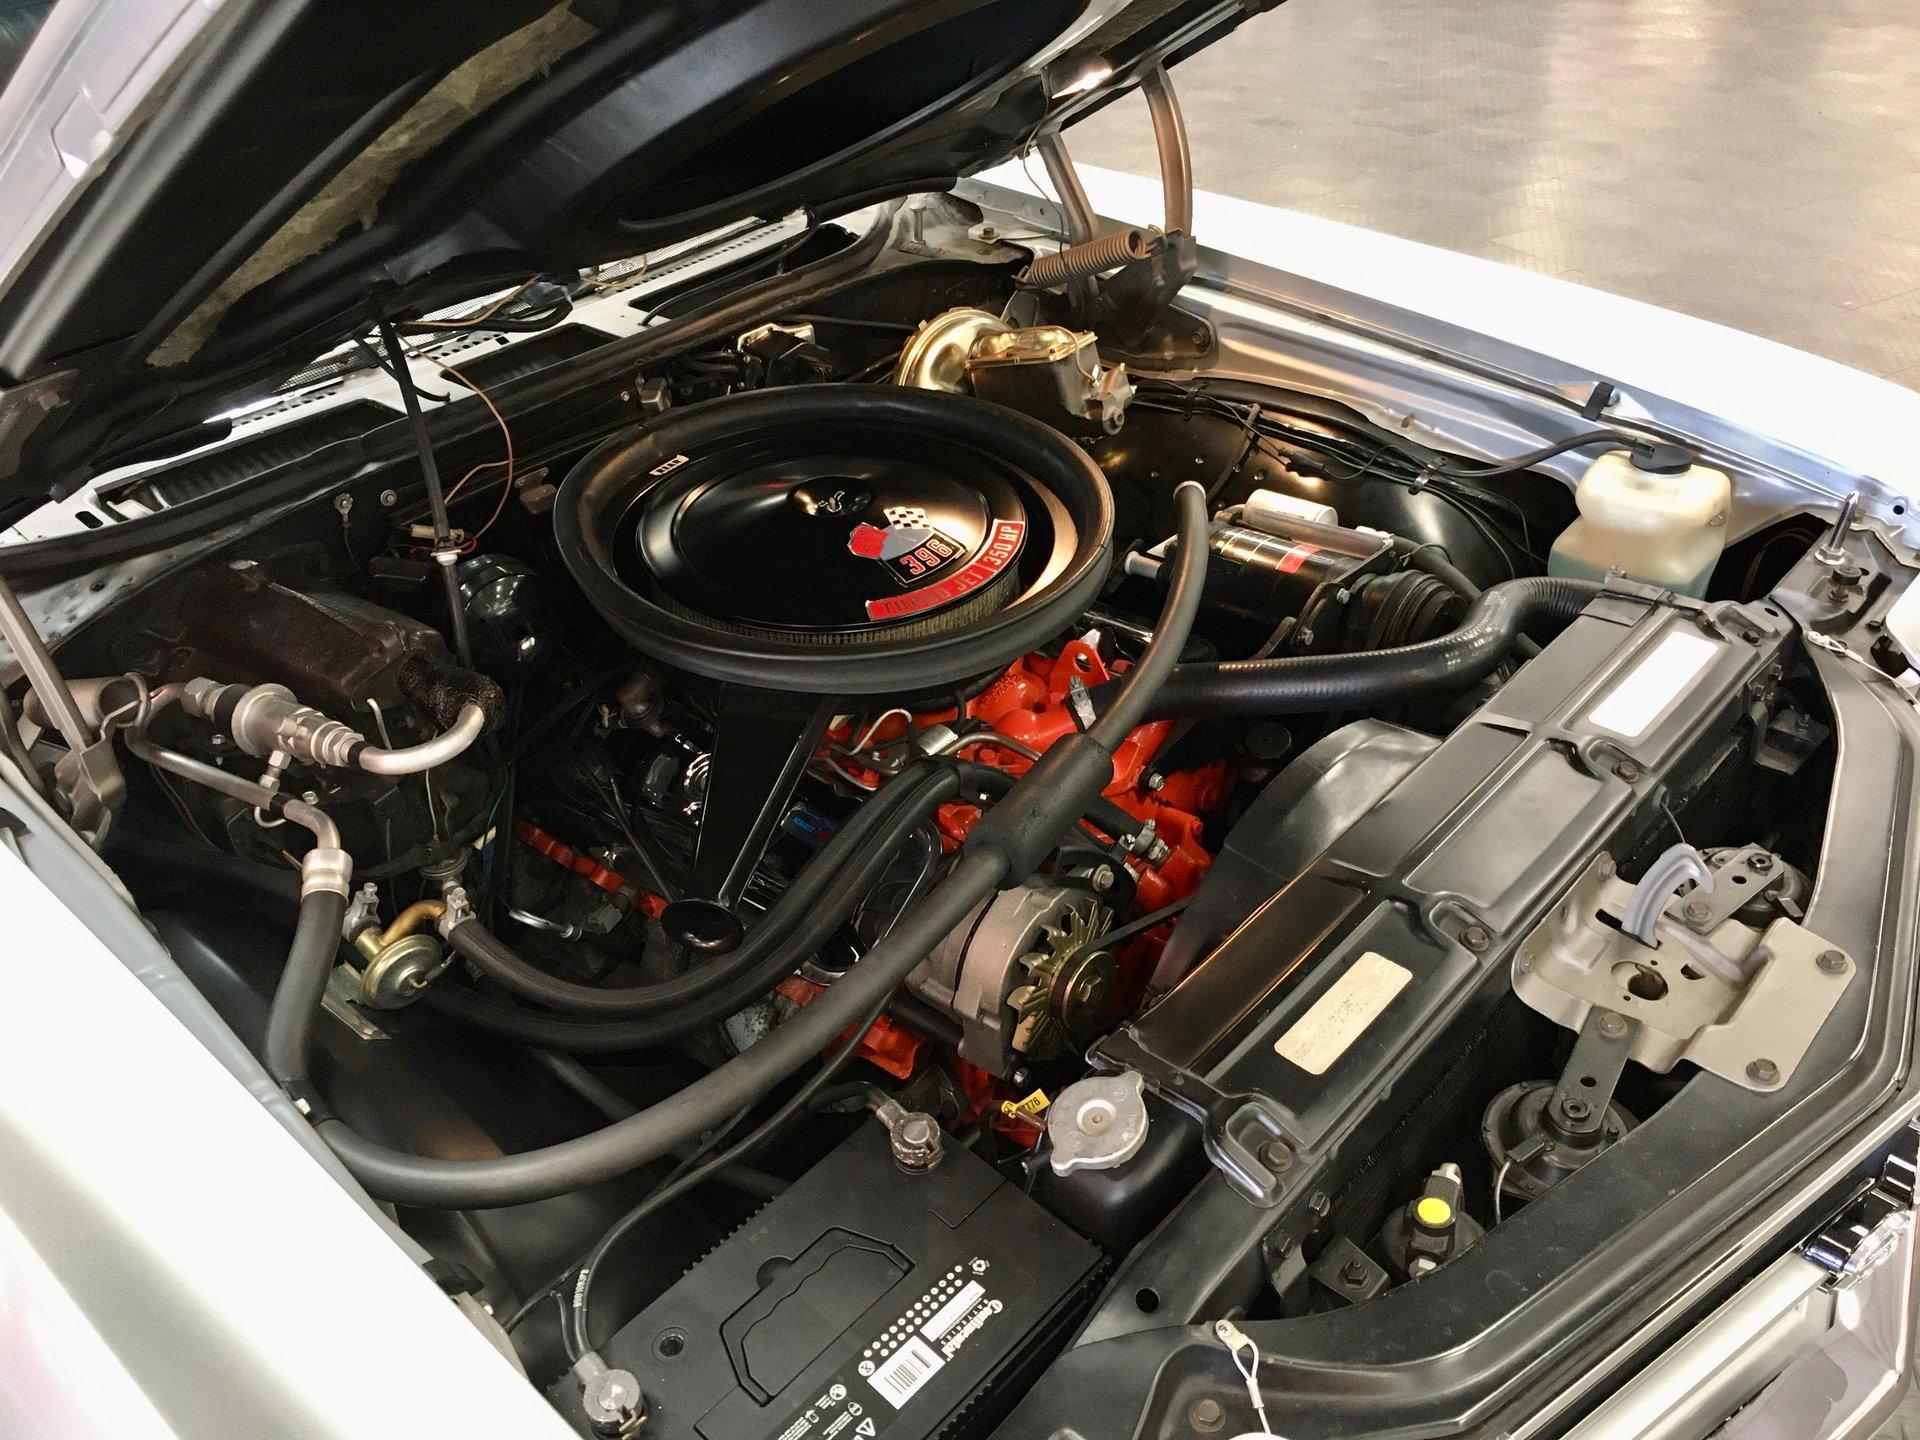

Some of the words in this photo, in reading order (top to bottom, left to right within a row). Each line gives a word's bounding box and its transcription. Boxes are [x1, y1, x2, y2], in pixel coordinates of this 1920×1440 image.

[899, 538, 954, 576] 396
[982, 542, 1013, 566] 350
[1001, 525, 1020, 543] HP
[957, 570, 985, 591] JET
[940, 1299, 989, 1346] BATTERIES
